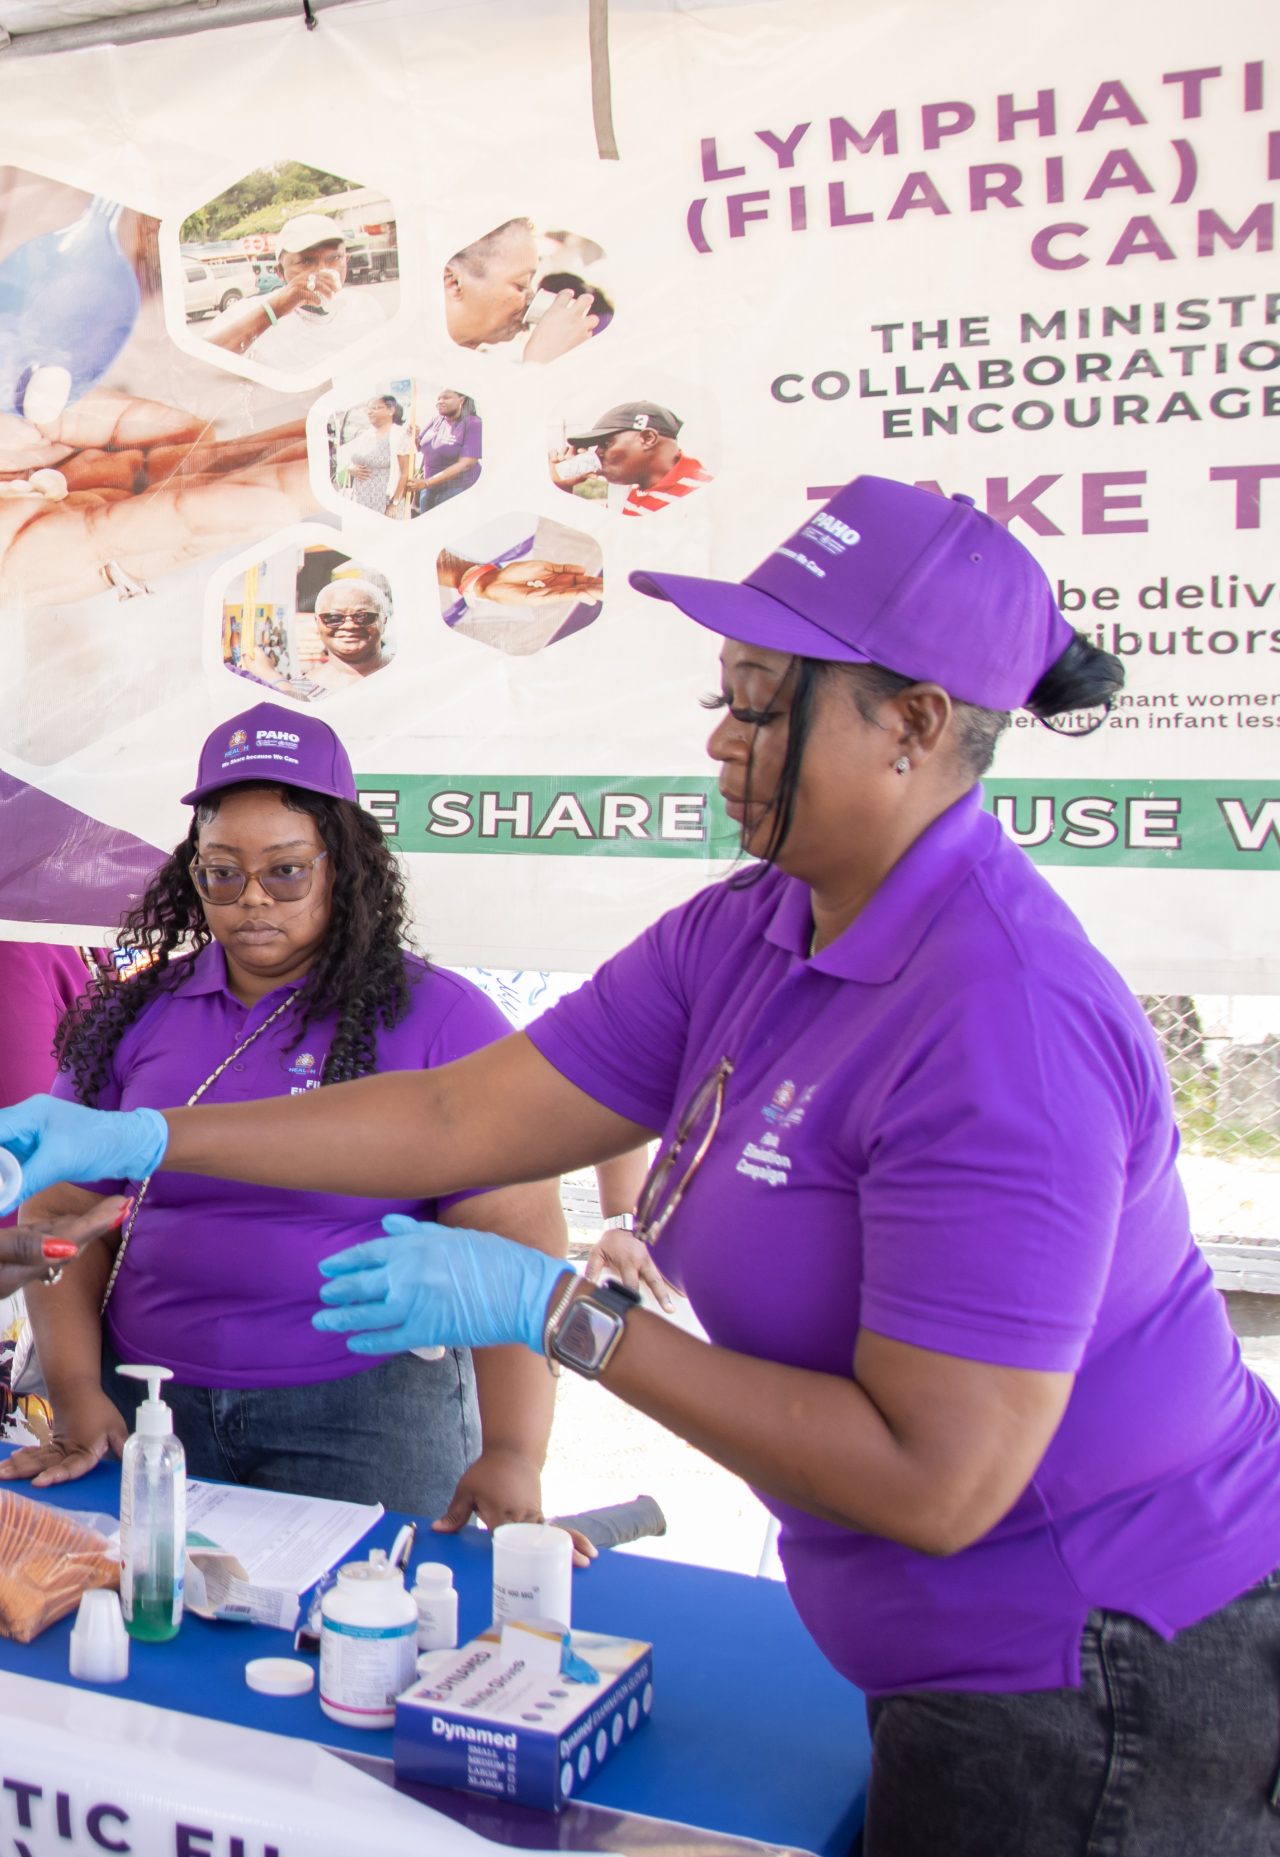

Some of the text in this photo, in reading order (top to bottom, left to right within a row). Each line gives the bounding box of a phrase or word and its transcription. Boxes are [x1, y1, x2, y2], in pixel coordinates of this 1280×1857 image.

[700, 60, 1265, 183] LYMPHATI
[686, 138, 1198, 254] (FILARIA)
[1031, 202, 1274, 271] CAM
[871, 315, 991, 354] THE
[770, 339, 1280, 404] COLLABORATIO
[811, 511, 861, 545] PAHO
[1057, 574, 1280, 611] be deliv
[1084, 623, 1280, 655] ibutors
[256, 730, 300, 743] PAHO
[1109, 716, 1139, 728] an
[1148, 712, 1228, 728] infant
[1237, 712, 1280, 728] les
[425, 791, 708, 842] SHARE
[431, 1715, 518, 1751] Dynamed
[468, 1744, 499, 1759] SMALL
[468, 1754, 506, 1771] MEDIUM
